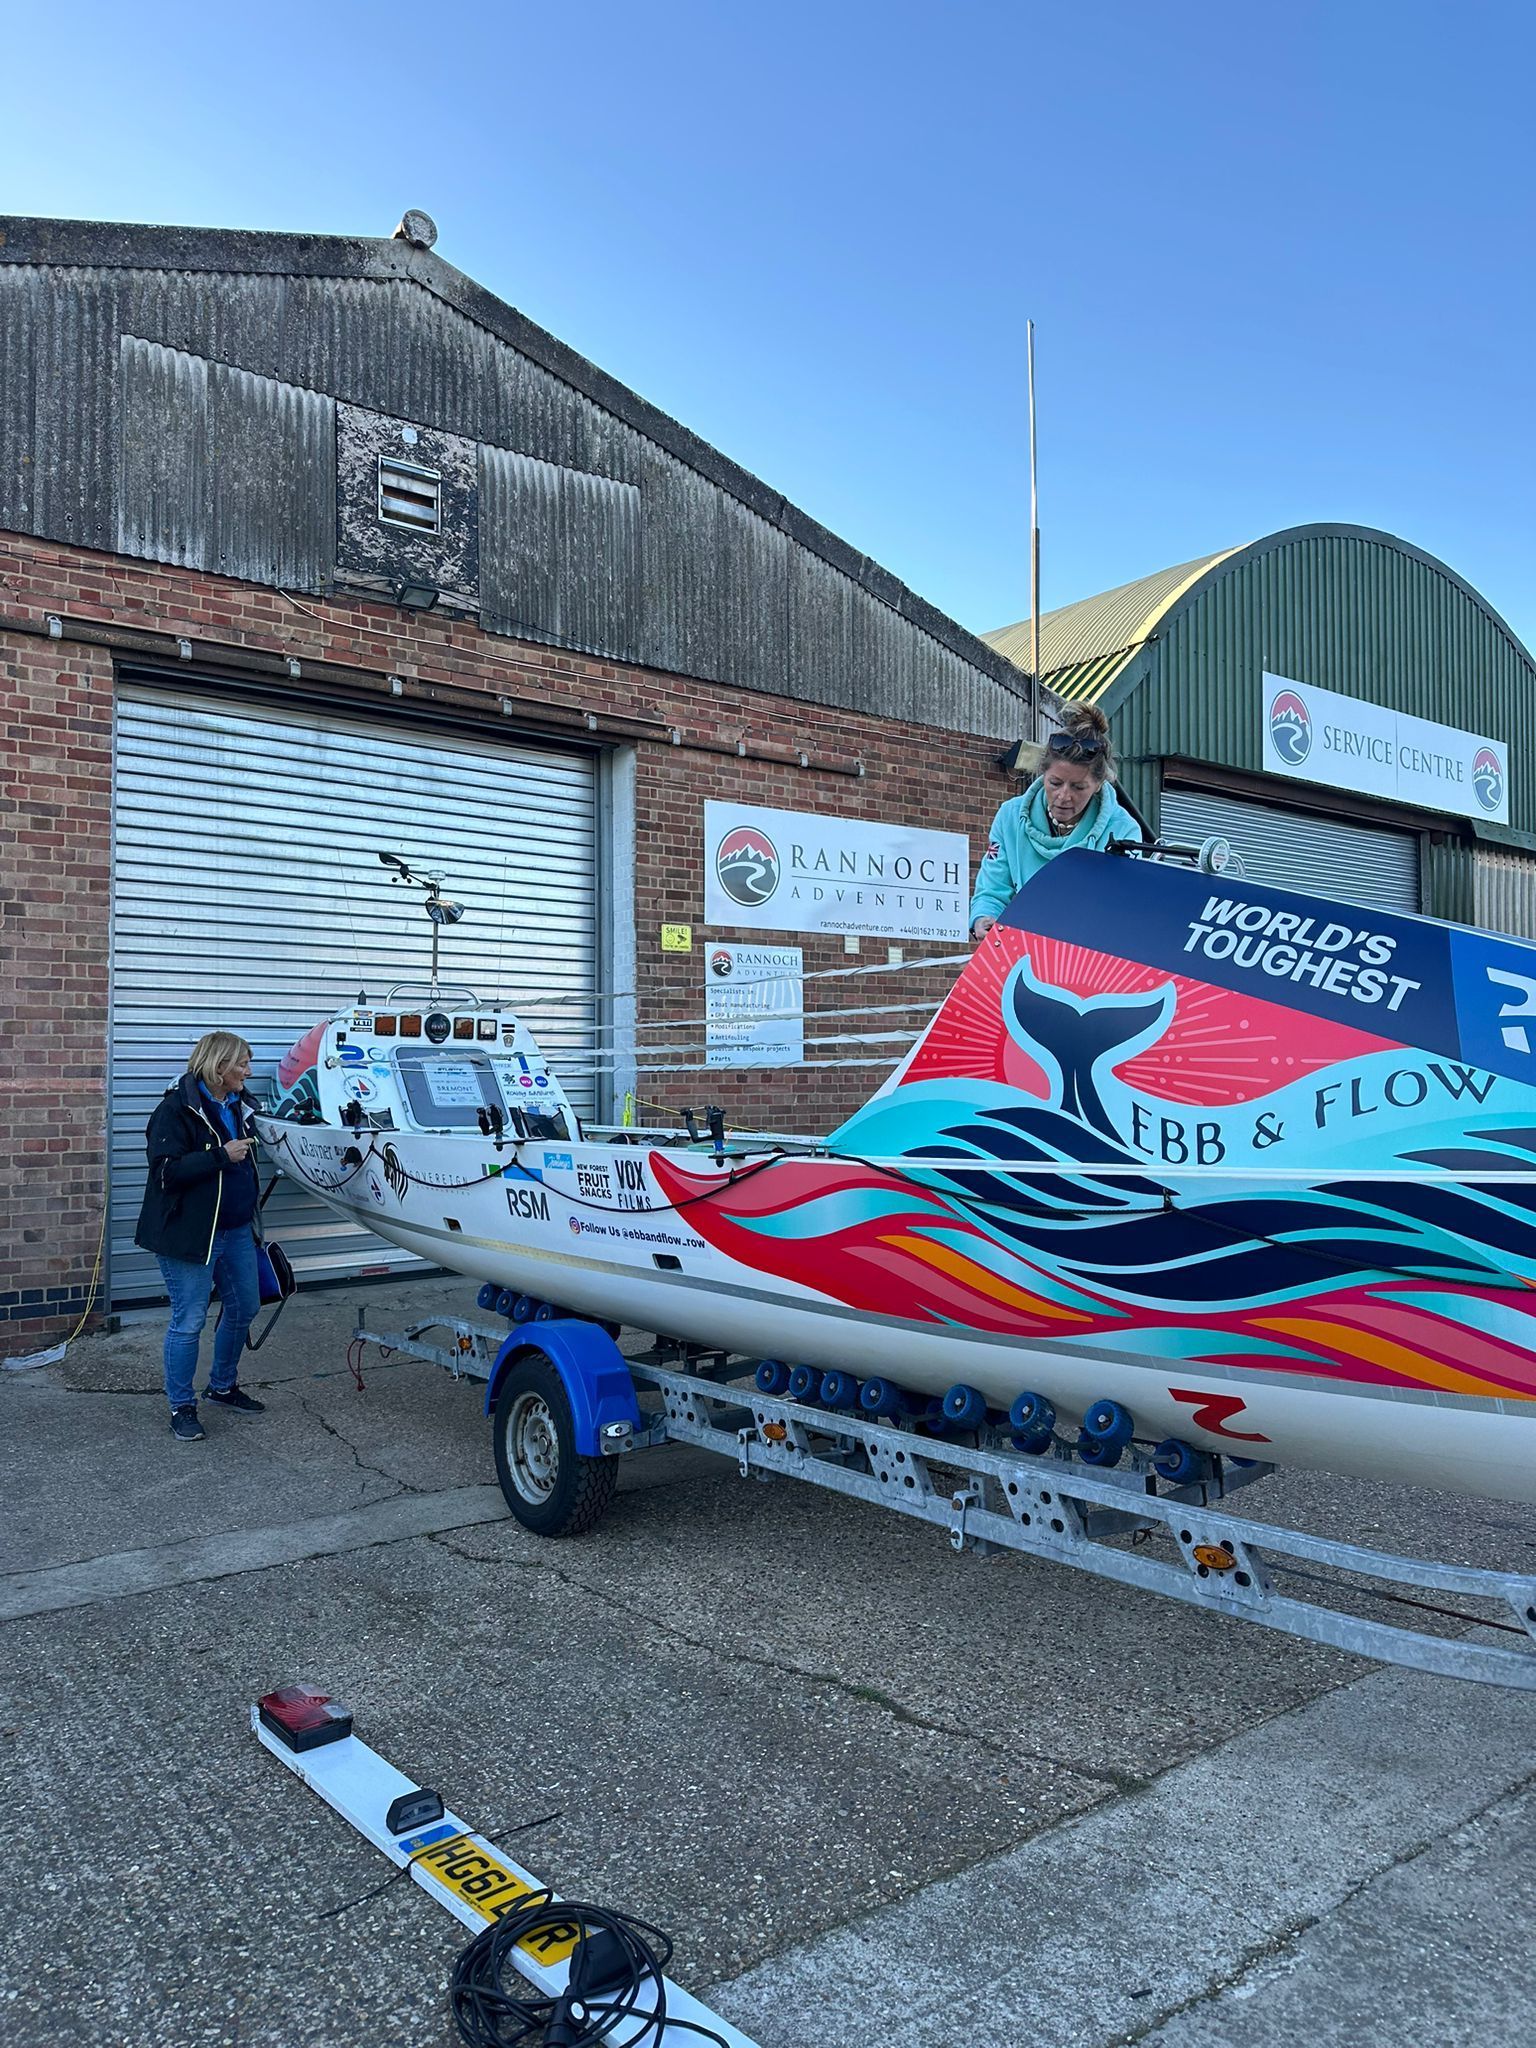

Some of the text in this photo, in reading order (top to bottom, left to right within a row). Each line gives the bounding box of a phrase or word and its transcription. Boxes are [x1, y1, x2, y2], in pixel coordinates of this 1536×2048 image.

[1323, 725, 1464, 783] SERVICE CENTRE
[791, 844, 960, 885] RANNOCH
[791, 886, 960, 912] ADVENTURE
[820, 920, 961, 938] rannochadventure.com +44(0)1621 782 127
[1200, 896, 1397, 965] WORLD'S
[737, 953, 798, 966] RANNOCH
[1183, 922, 1421, 1011] TOUGHEST
[1132, 1063, 1496, 1165] EBB & FLOW
[576, 1163, 608, 1172] NEW FOREST
[577, 1172, 610, 1188] FRUIT
[614, 1159, 646, 1191] VOX
[505, 1187, 551, 1221] RSM
[580, 1186, 612, 1199] SNACKS
[617, 1193, 652, 1211] FILMS
[580, 1221, 706, 1249] Follow Us @ebbandflow_row
[427, 1841, 517, 1902] HG61
